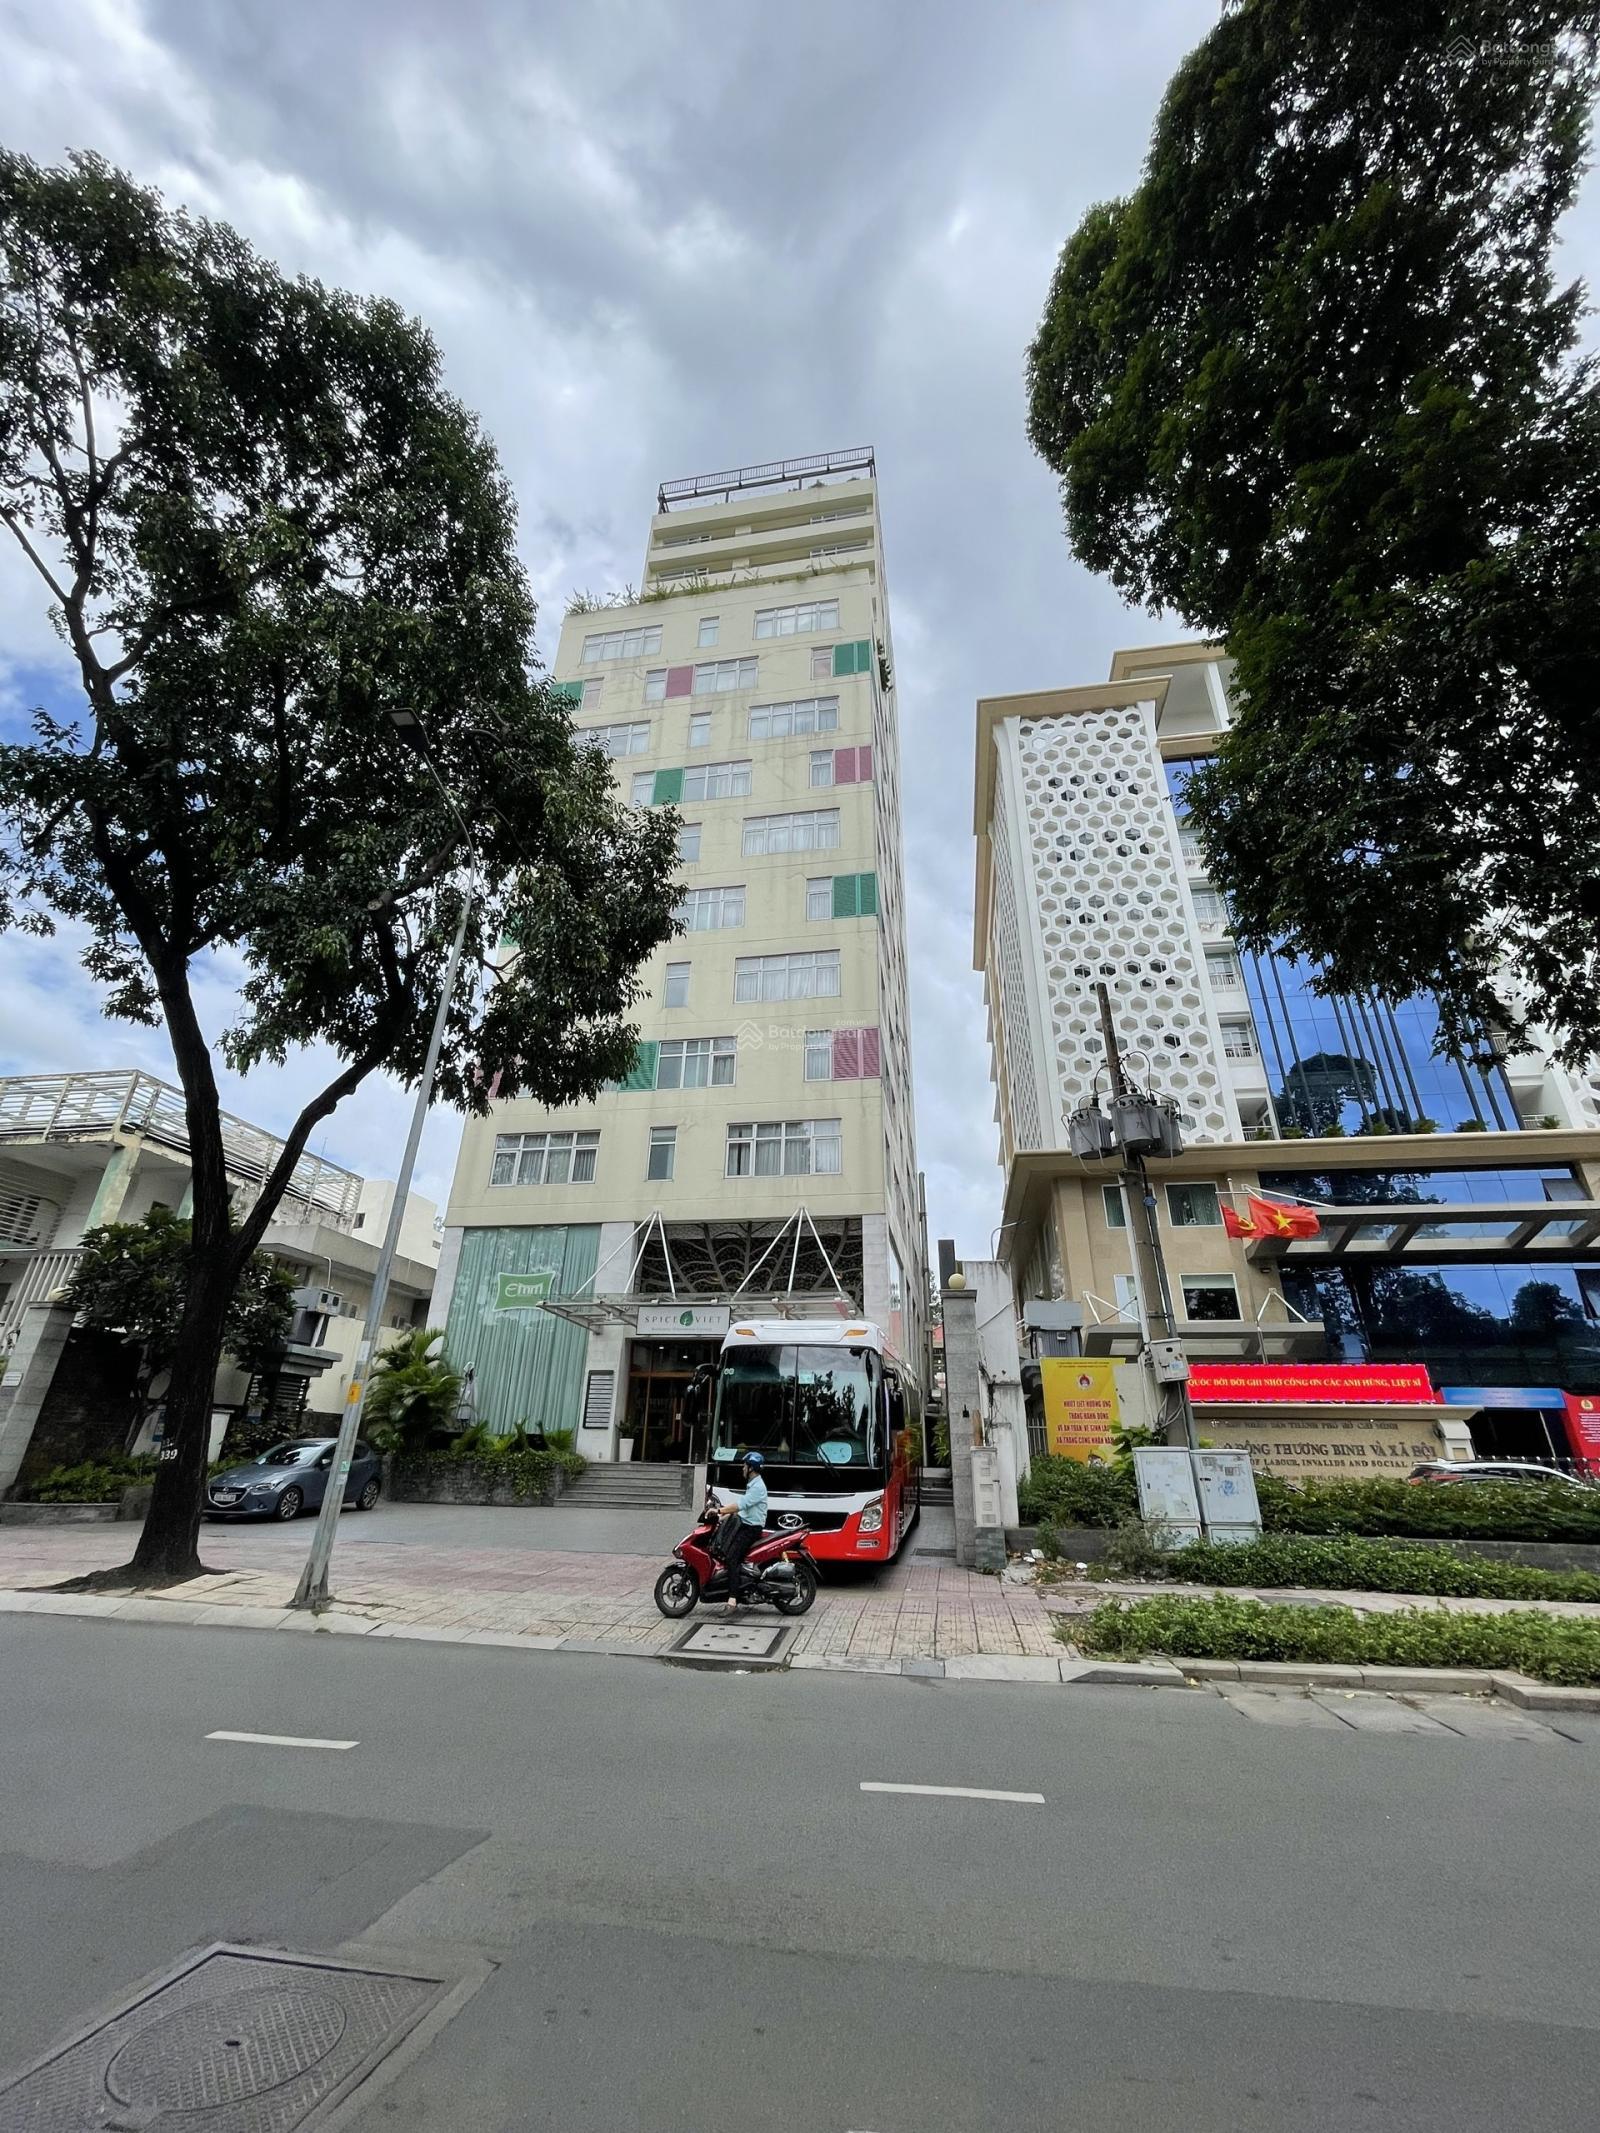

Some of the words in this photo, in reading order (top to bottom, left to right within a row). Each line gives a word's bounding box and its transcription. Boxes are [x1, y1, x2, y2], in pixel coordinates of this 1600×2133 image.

[1274, 1442, 1329, 1456] THƯƠNG
[1331, 1444, 1366, 1456] BINH
[1369, 1440, 1387, 1456] VÀ
[1389, 1441, 1409, 1457] XÃ
[1411, 1441, 1437, 1460] HỘI
[1302, 1459, 1346, 1467] INVALIDS
[1371, 1460, 1408, 1468] SOCIAL
